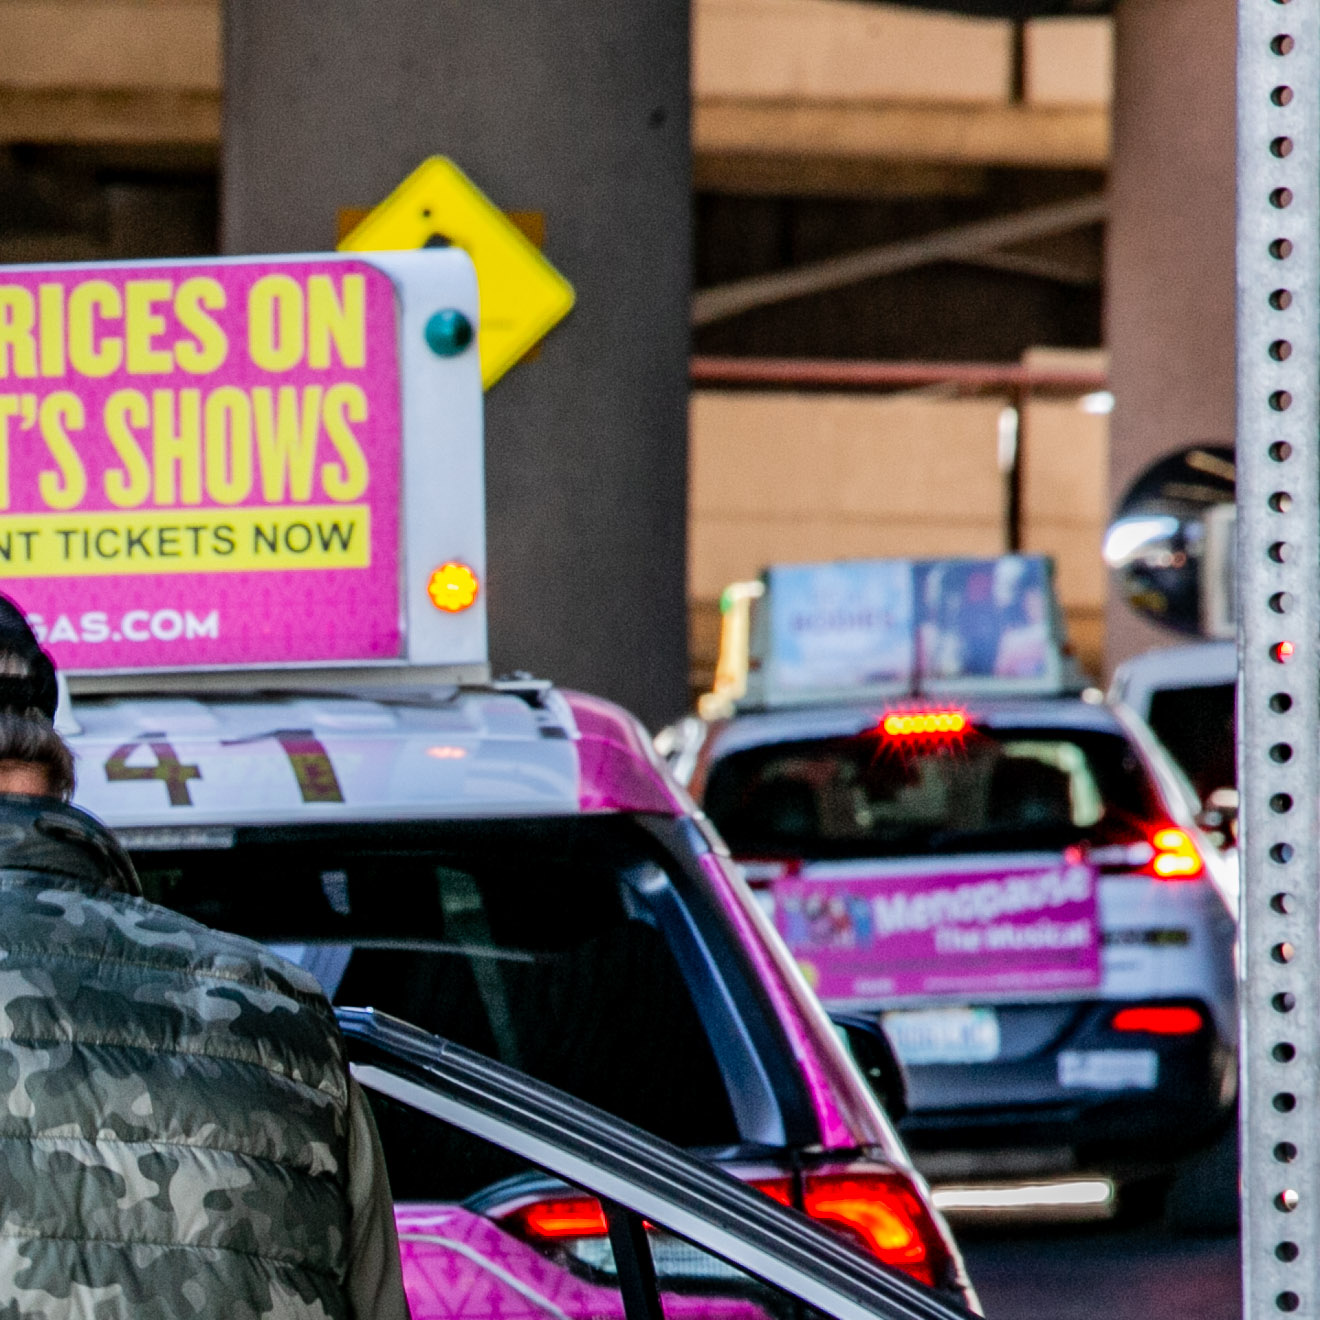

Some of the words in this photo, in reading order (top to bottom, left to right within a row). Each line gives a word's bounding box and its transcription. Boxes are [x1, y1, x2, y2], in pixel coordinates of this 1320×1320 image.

[248, 273, 366, 375] ON
[103, 383, 369, 507] SHOWS
[59, 525, 235, 560] TICKETS
[254, 521, 356, 554] NOW
[874, 867, 1092, 936] Menopause
[988, 919, 1091, 951] Musical
